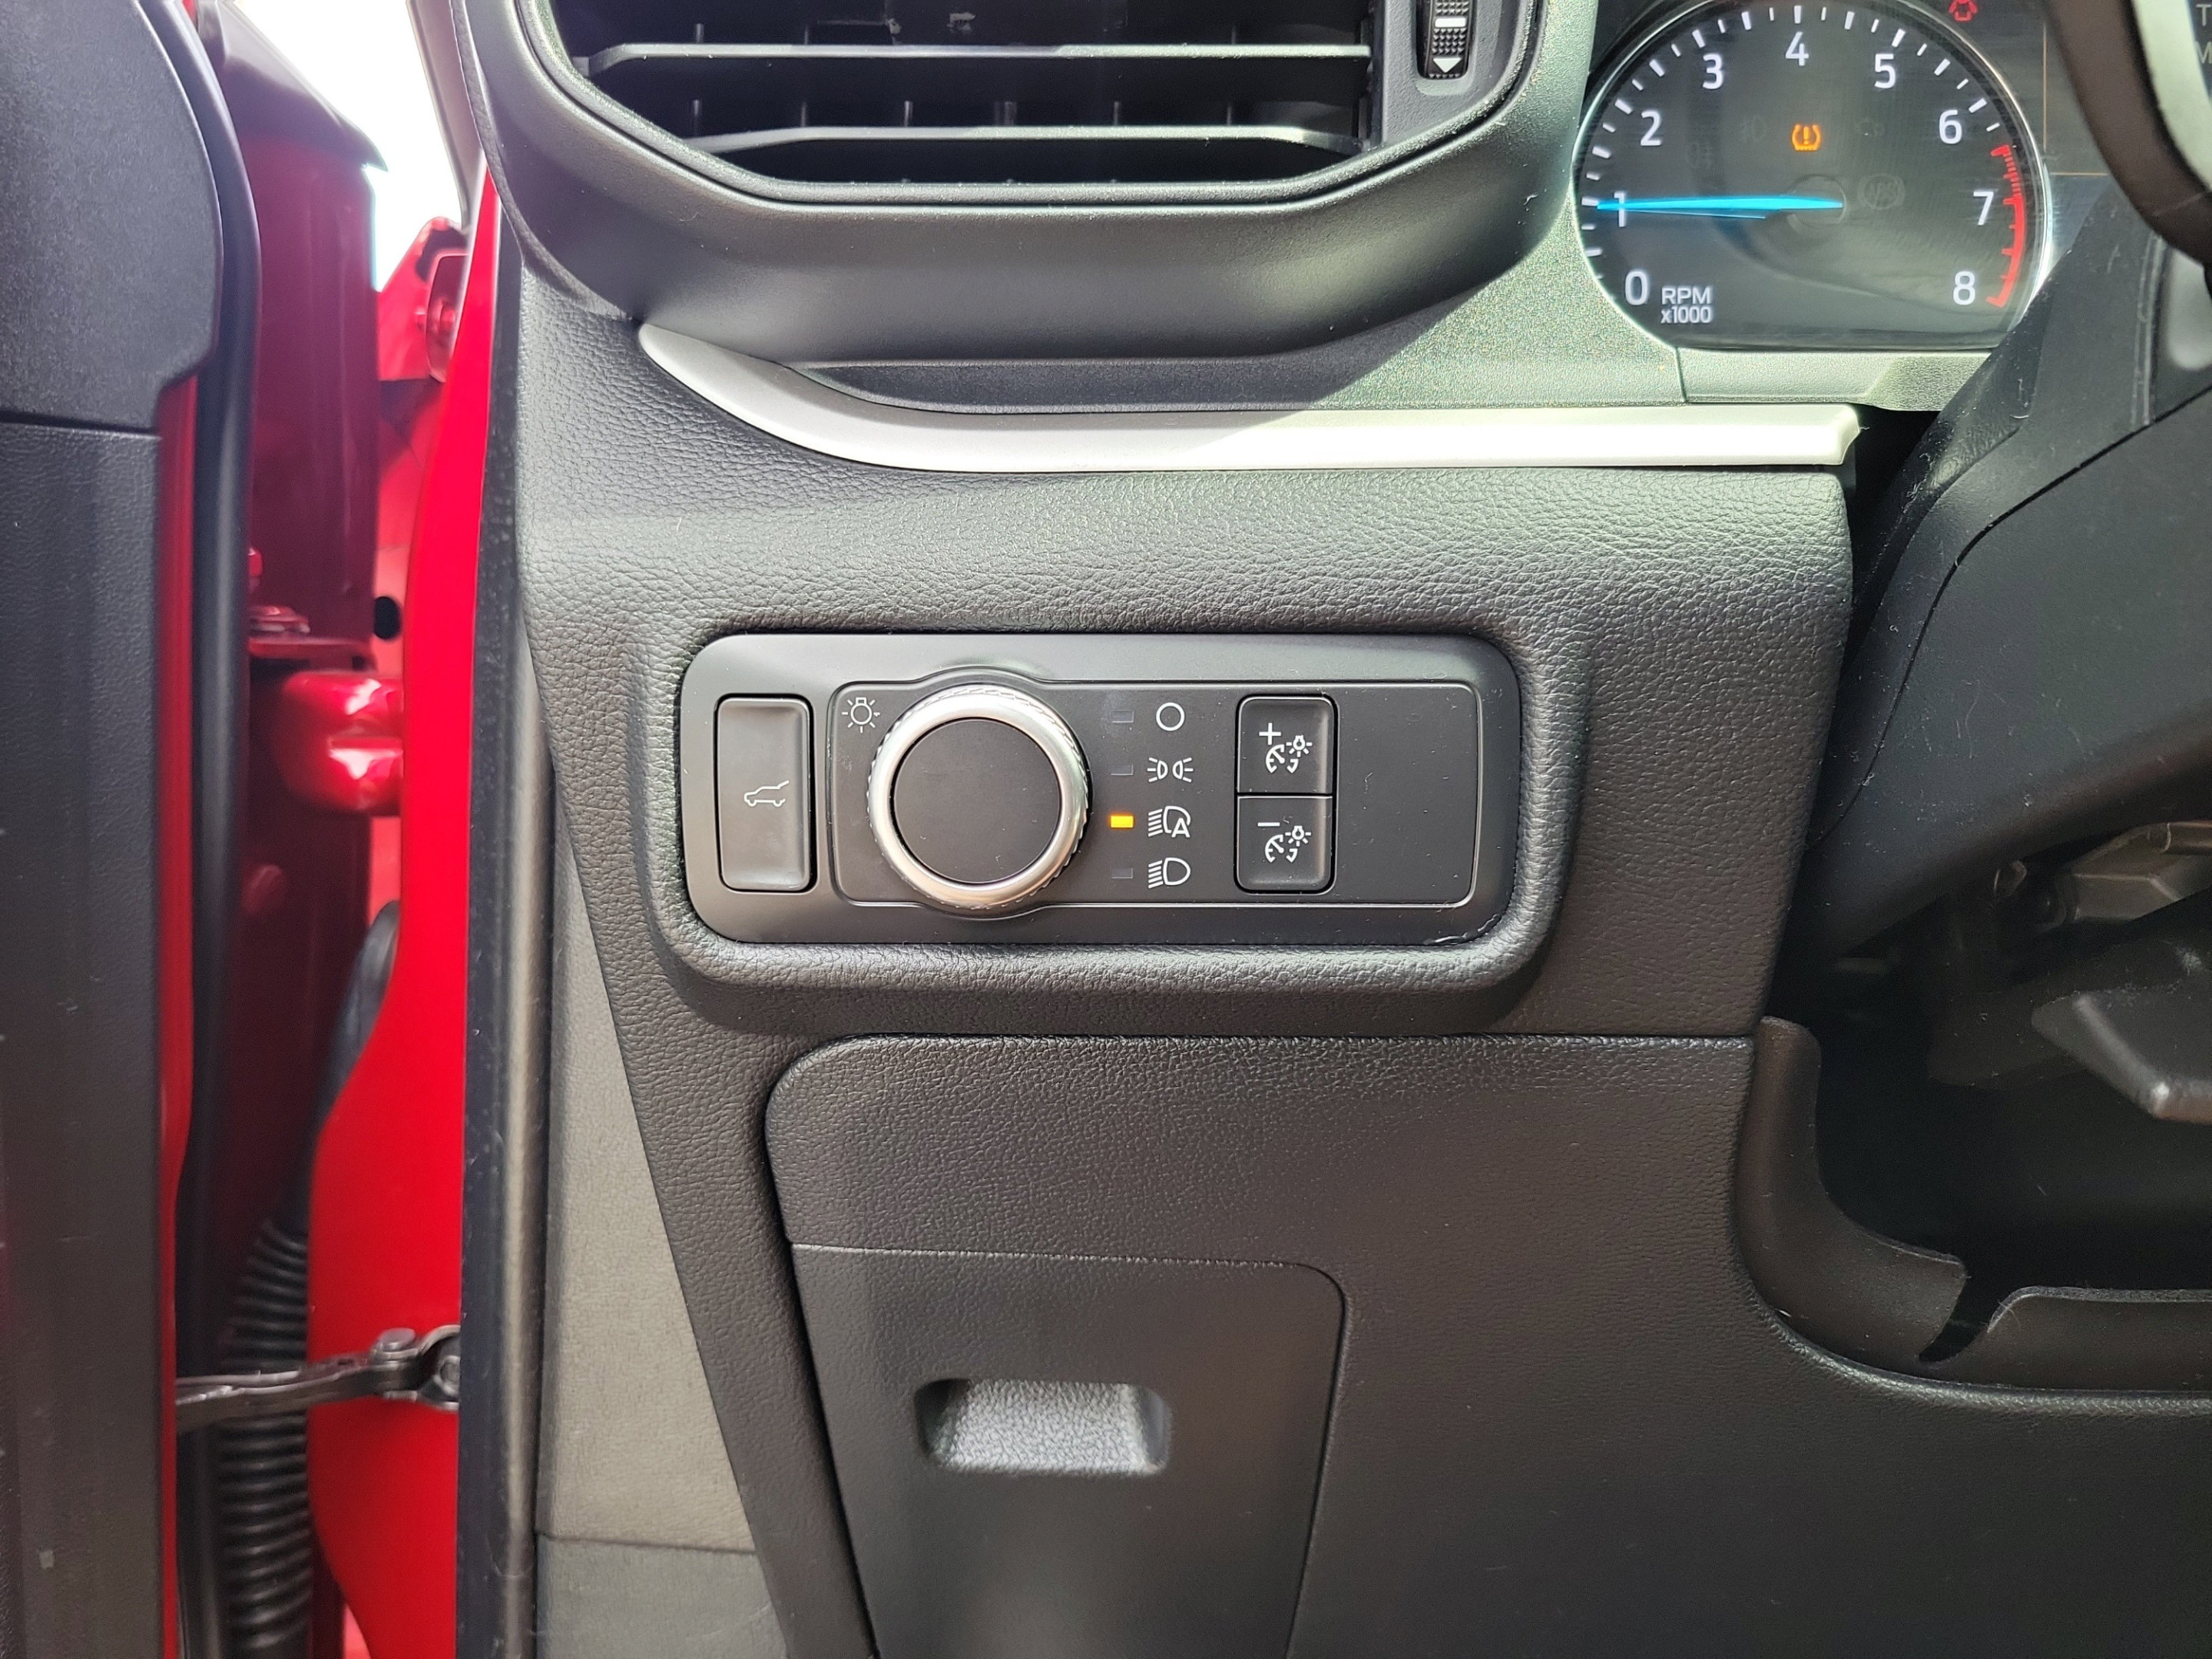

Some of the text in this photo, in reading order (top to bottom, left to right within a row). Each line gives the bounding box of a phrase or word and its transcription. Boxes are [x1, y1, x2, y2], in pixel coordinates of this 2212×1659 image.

[1786, 32, 1809, 65] 4
[1702, 54, 1724, 89] 3
[1874, 54, 1896, 89] 5
[1640, 111, 1662, 146] 2
[1939, 110, 1962, 144] 6
[1614, 191, 1627, 227] 1
[1972, 191, 1995, 226] 7
[1624, 270, 1649, 306] 0
[1661, 286, 1712, 305] RPM
[1953, 271, 1976, 305] 8
[1661, 306, 1713, 324] x1000
